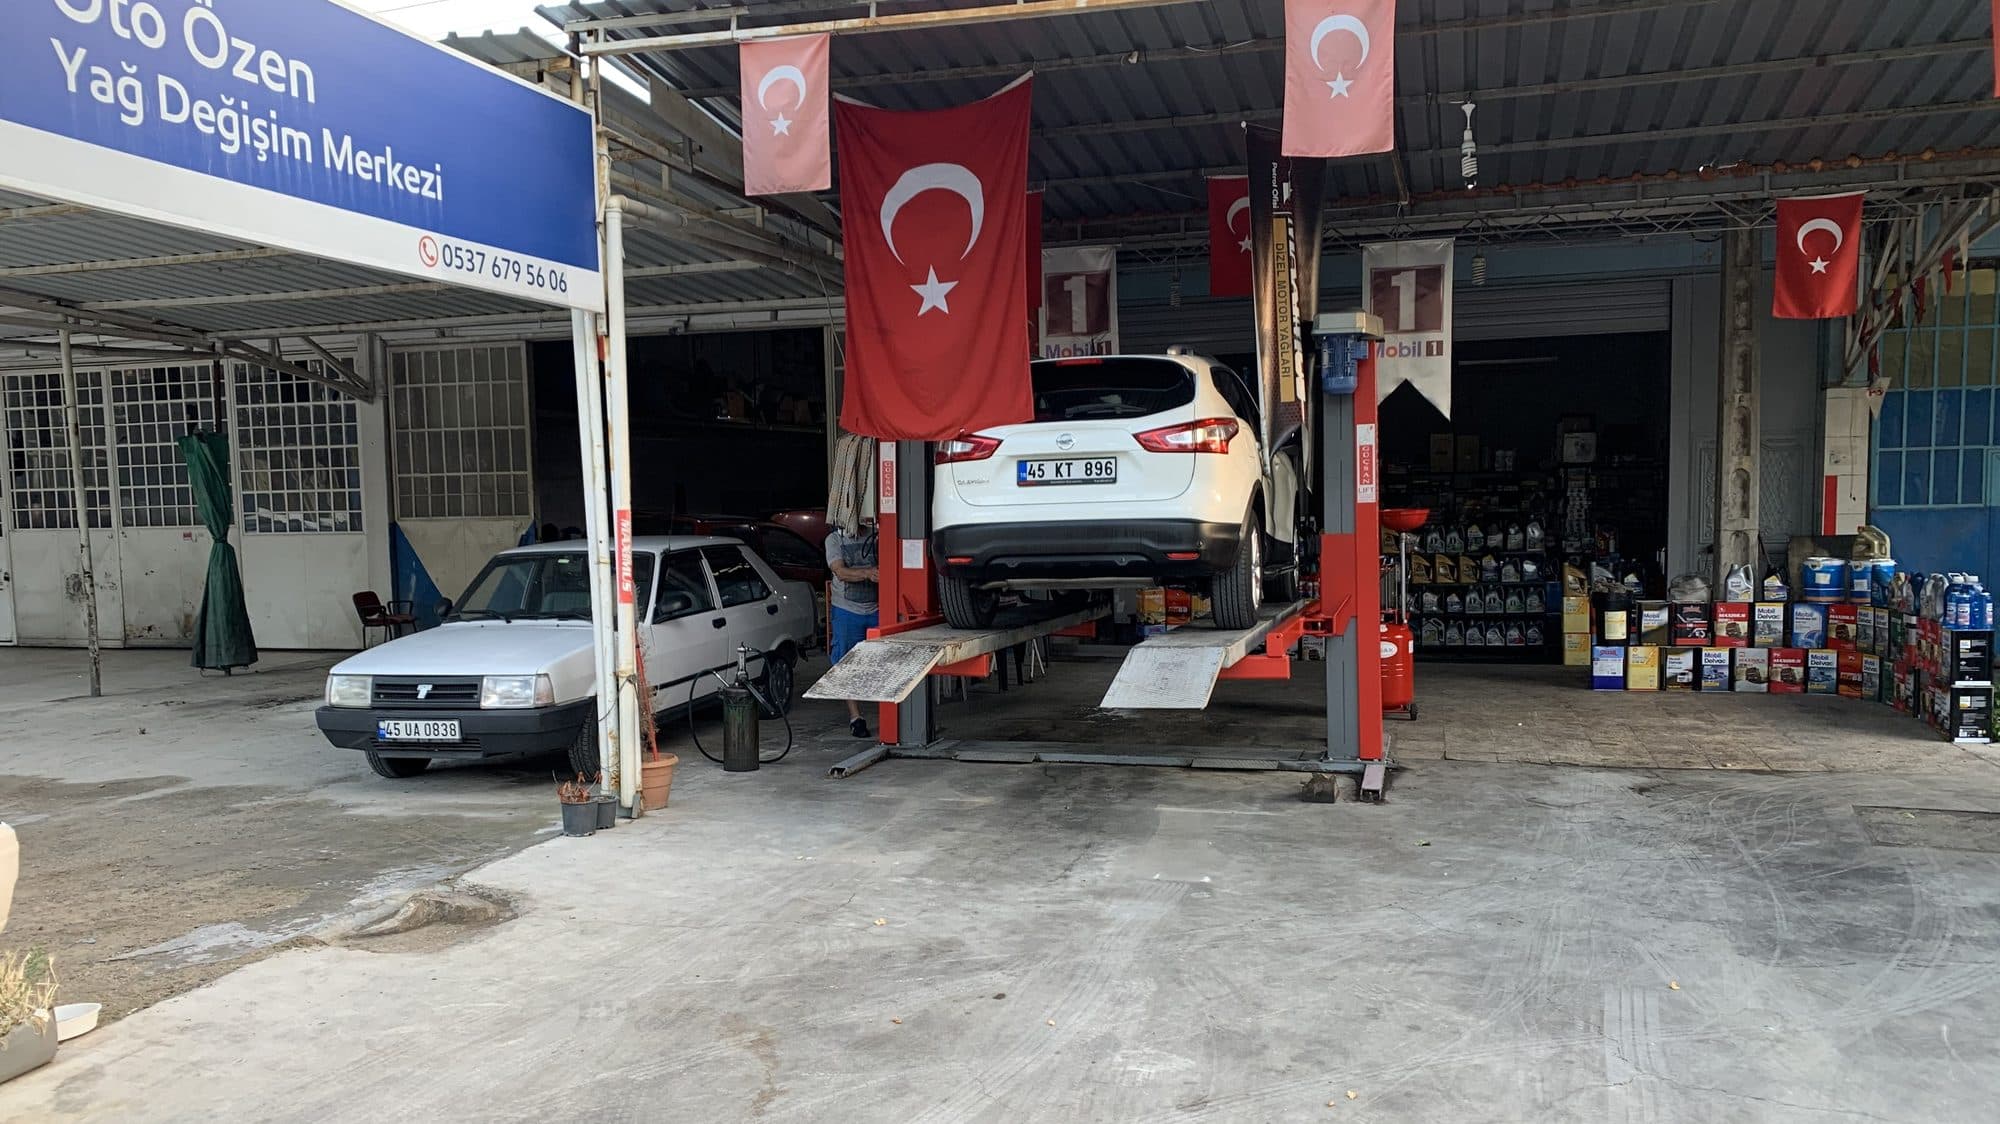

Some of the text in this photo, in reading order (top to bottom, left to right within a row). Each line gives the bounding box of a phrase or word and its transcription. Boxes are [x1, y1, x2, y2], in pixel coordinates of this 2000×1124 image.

[183, 0, 315, 104] Özen
[50, 37, 443, 201] Yağ Değişim Merkezi
[442, 243, 568, 293] 0537 679 56 06
[1063, 274, 1088, 334] 1
[1276, 280, 1288, 324] MOTOR
[1390, 269, 1416, 332] 1
[1027, 460, 1113, 479] 45 KT 896
[619, 518, 632, 592] MAXIMUS
[385, 722, 457, 737] 45 UA 0838
